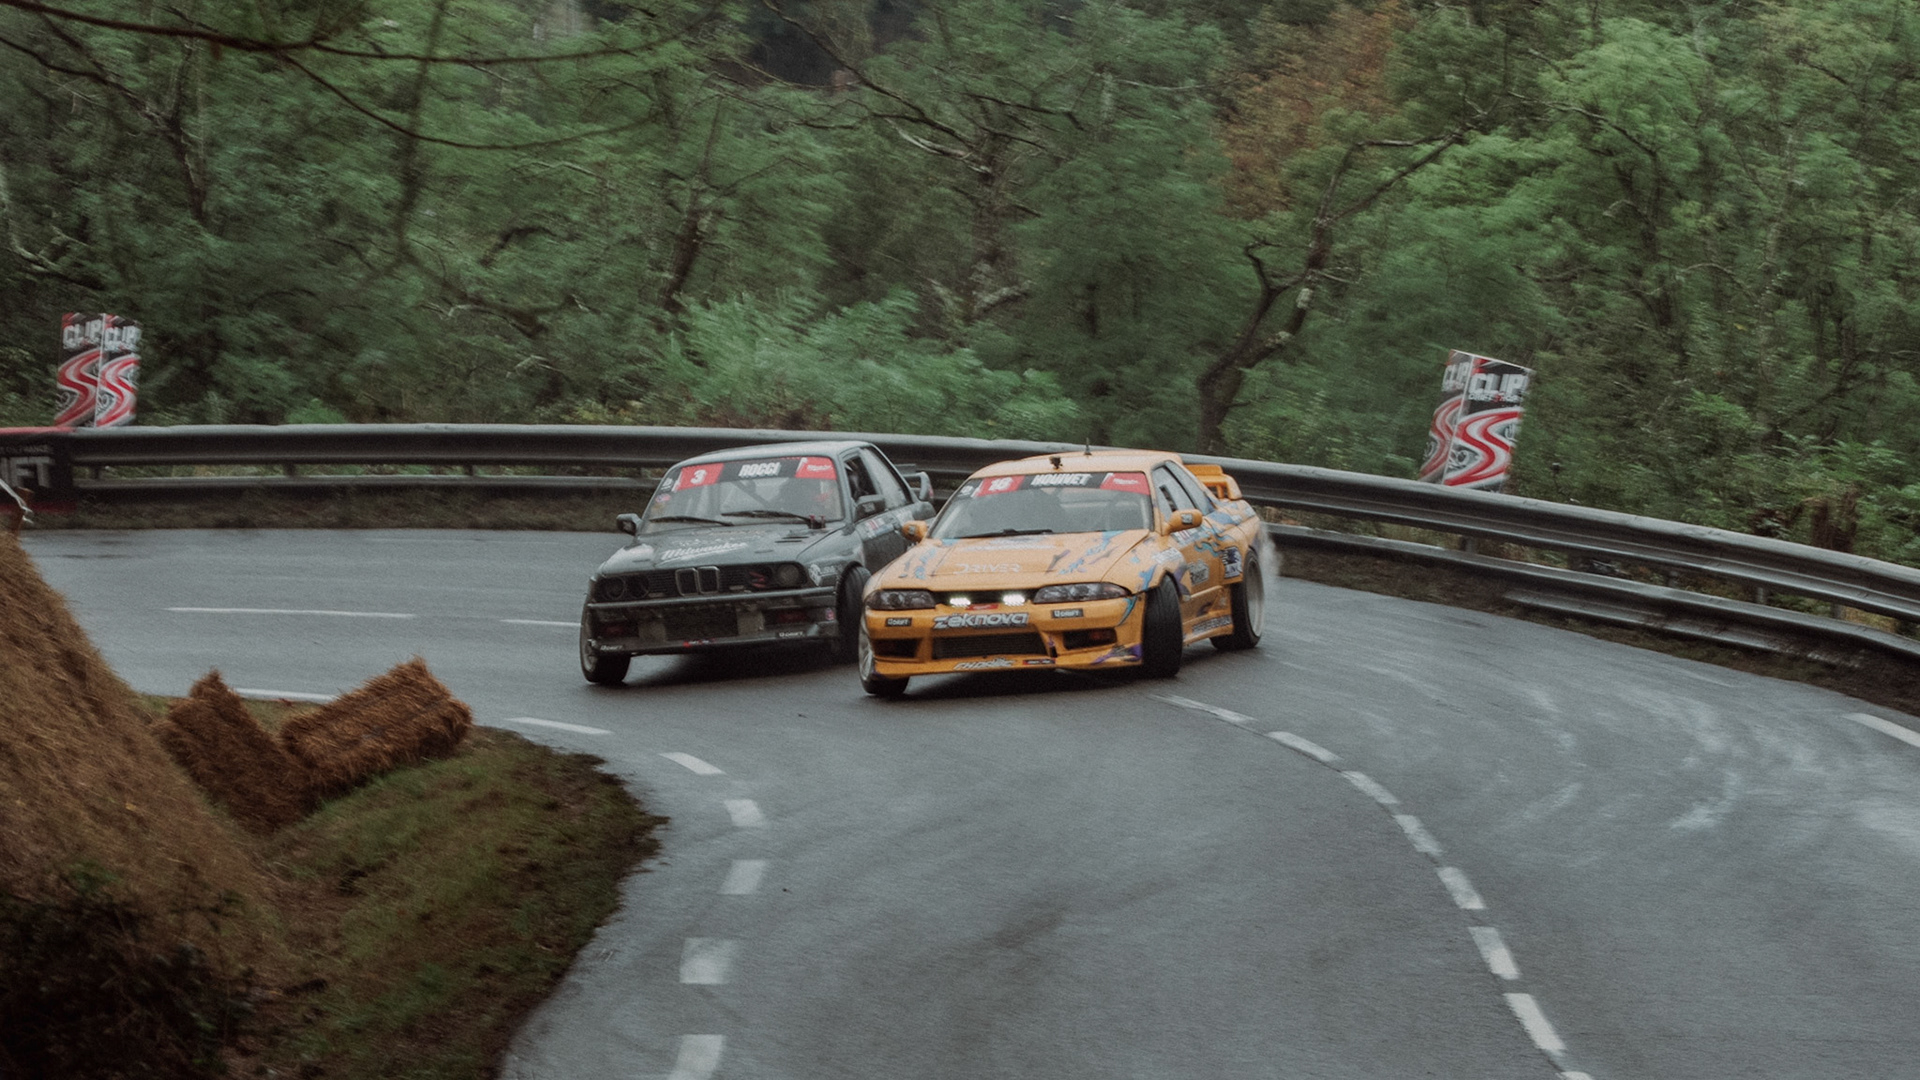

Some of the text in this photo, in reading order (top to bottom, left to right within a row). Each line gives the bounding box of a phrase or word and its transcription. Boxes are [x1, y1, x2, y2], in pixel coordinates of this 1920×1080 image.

[1470, 373, 1528, 395] CLIP
[690, 469, 707, 484] 3
[738, 462, 781, 478] ROCCI
